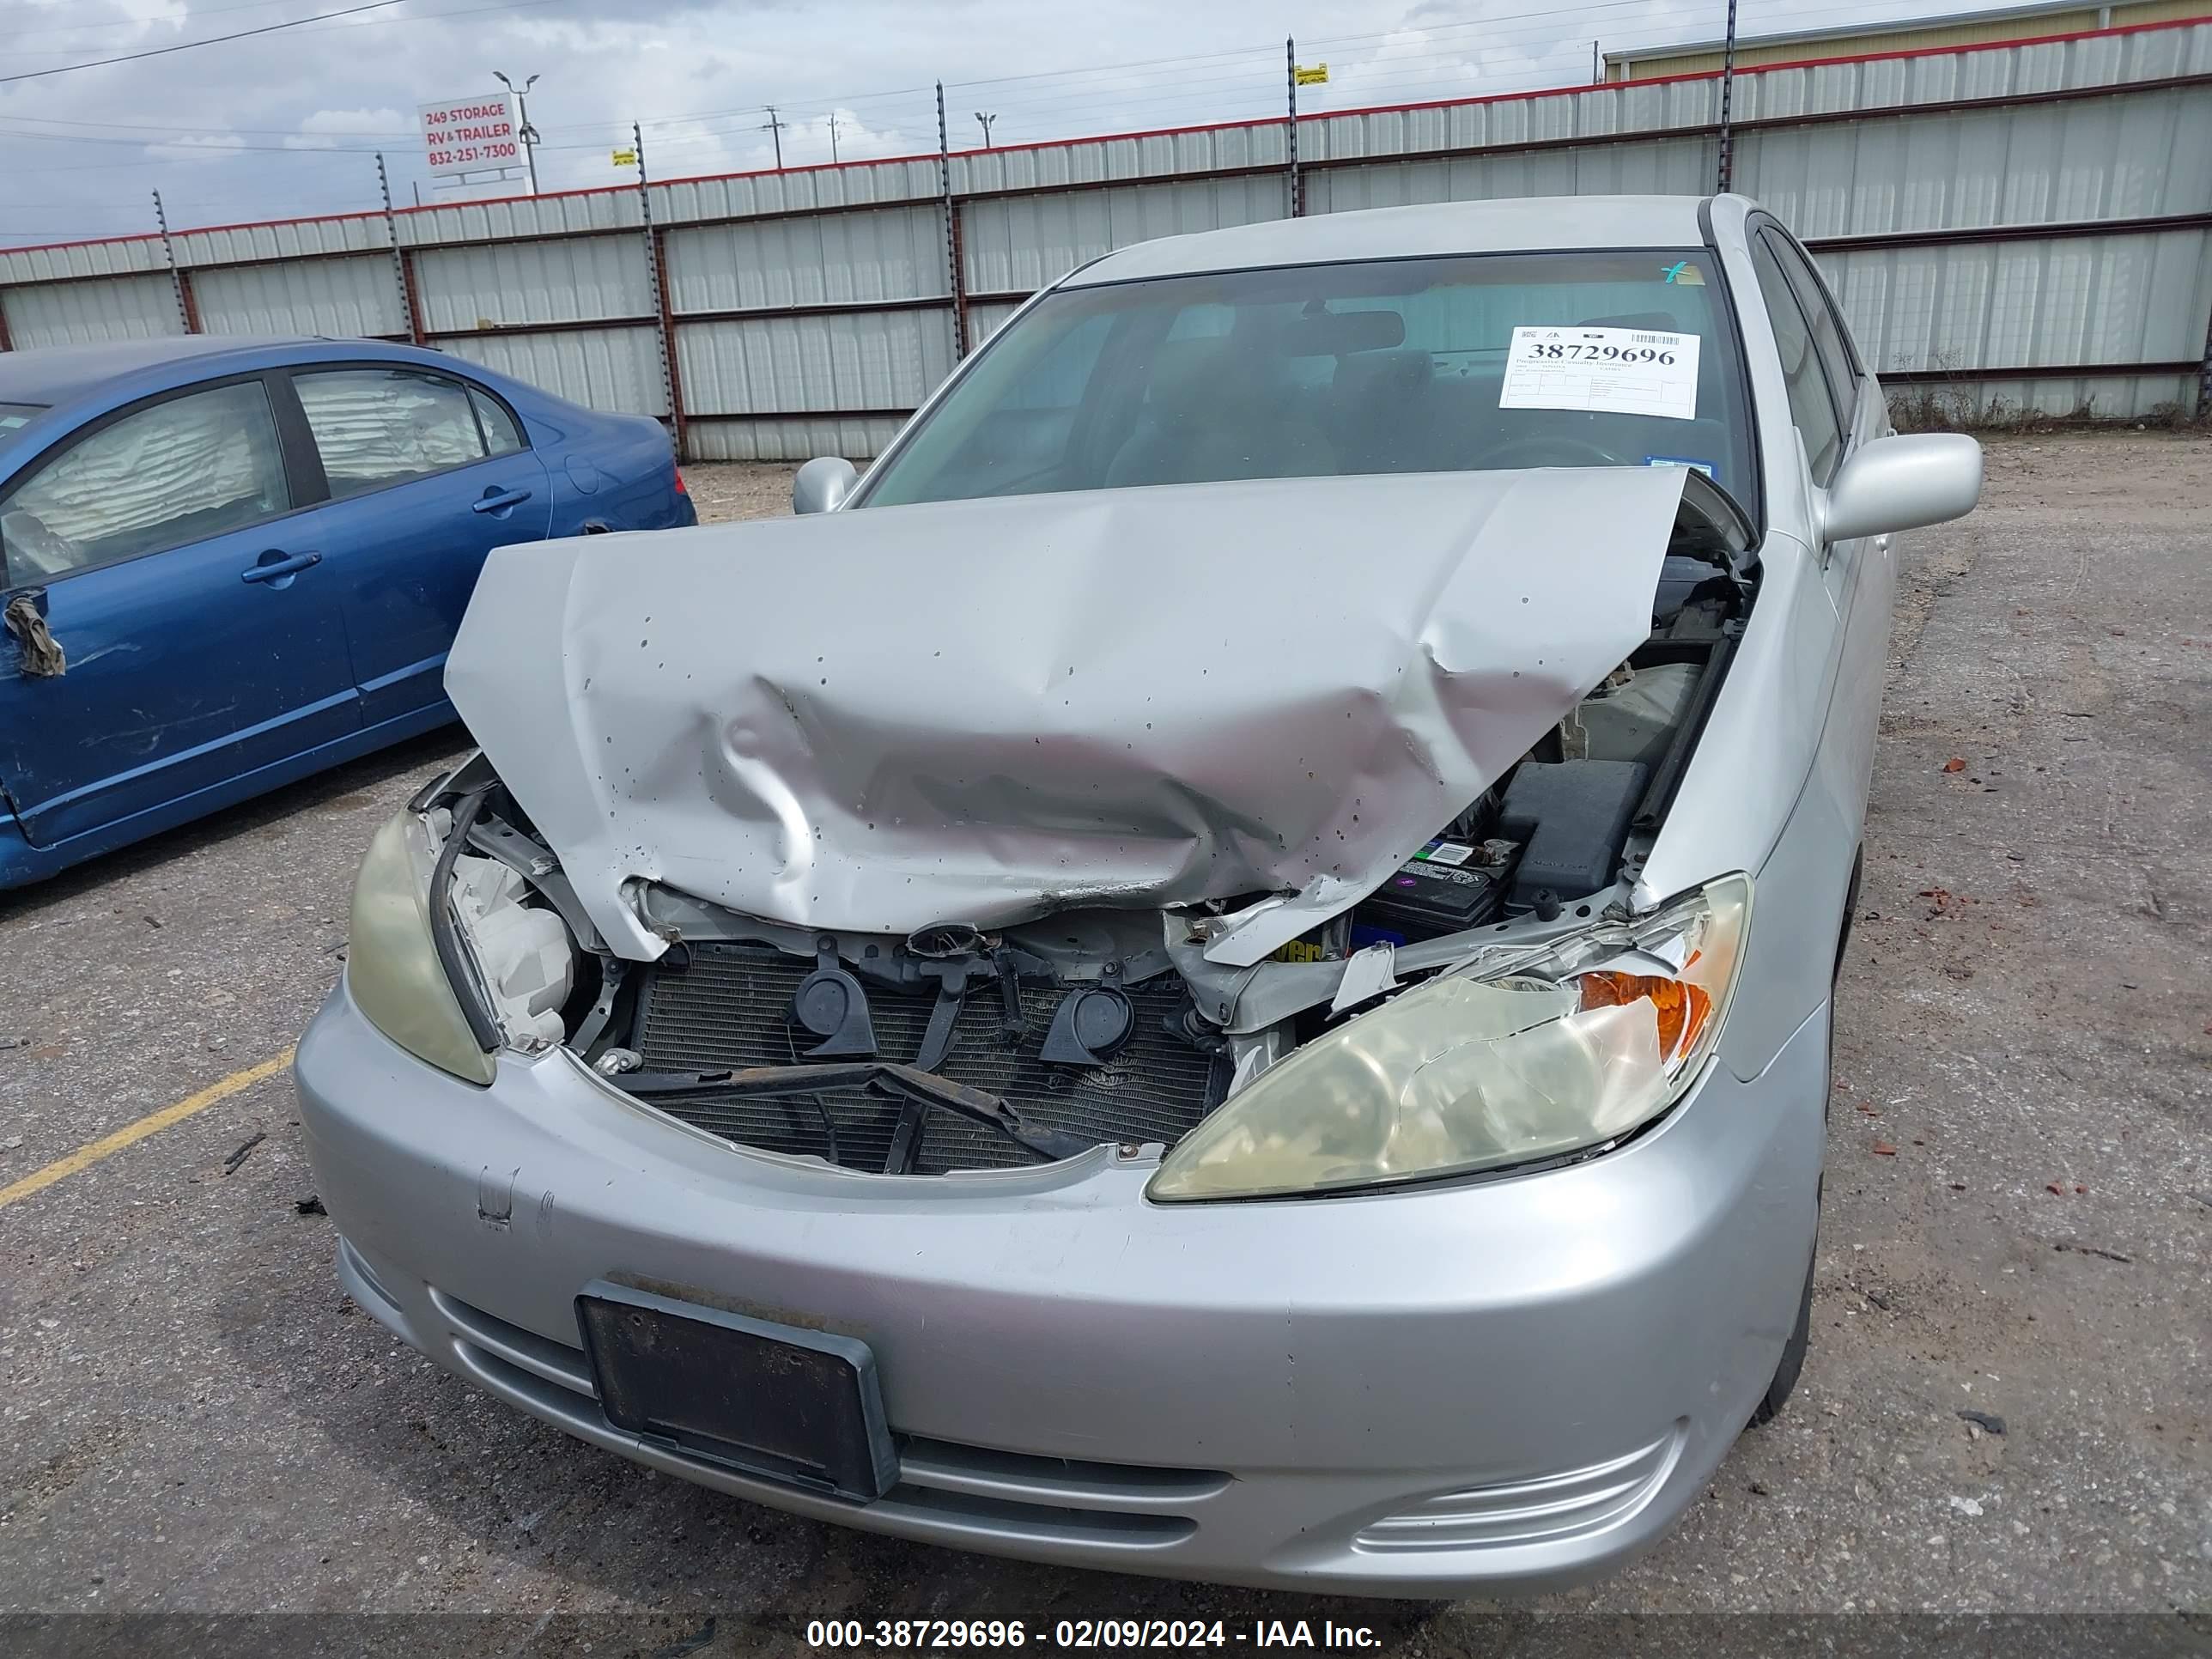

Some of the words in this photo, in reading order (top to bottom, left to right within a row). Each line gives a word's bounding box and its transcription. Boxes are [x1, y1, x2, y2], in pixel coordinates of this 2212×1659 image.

[426, 112, 447, 125] 249
[450, 103, 506, 122] STORAGE
[428, 131, 445, 146] RV
[447, 132, 454, 142] &
[455, 123, 511, 142] TRAILER
[429, 143, 515, 166] 832-251-7300
[1528, 343, 1675, 366] 38729696
